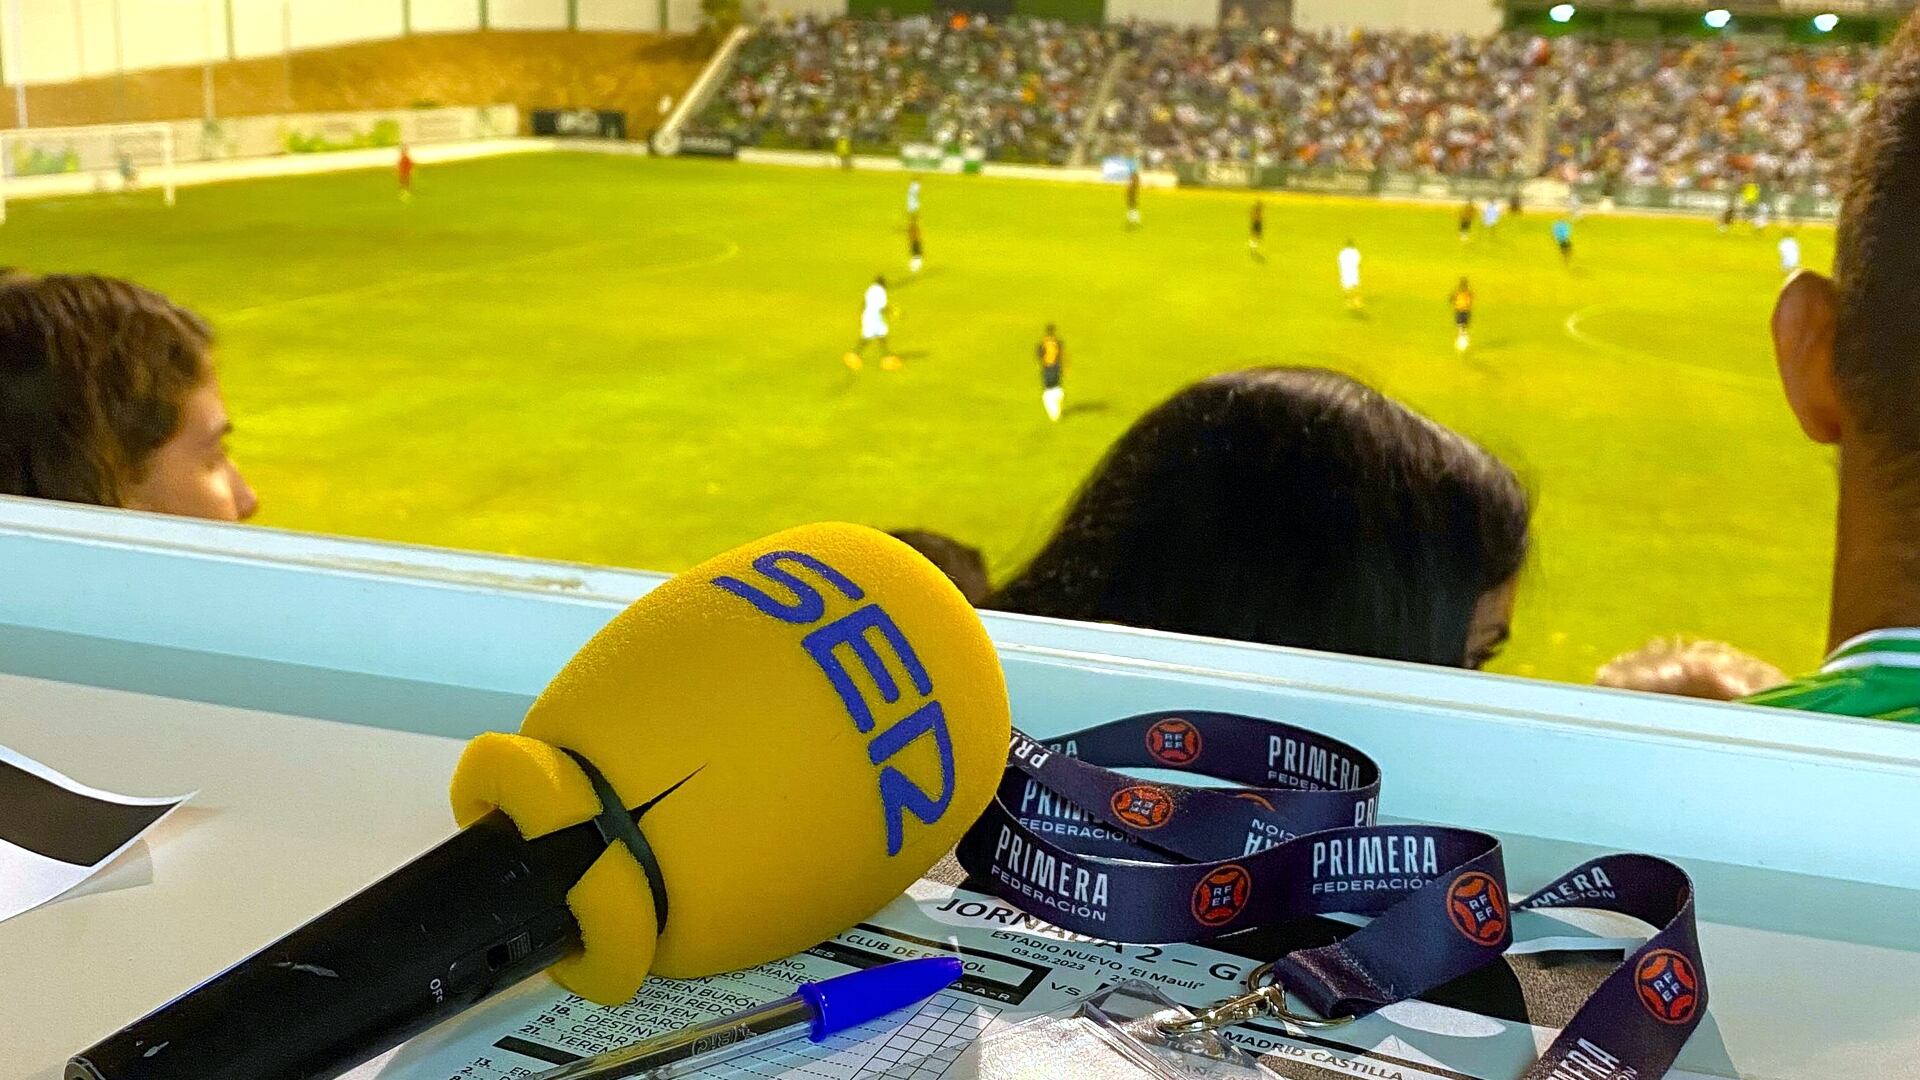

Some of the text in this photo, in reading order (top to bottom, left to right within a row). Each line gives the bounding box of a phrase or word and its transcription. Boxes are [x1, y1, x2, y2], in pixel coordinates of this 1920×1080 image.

[710, 551, 956, 856] SER
[1268, 735, 1360, 793] PRIMERA
[994, 823, 1108, 907] PRIMERA
[1313, 835, 1438, 878] PRIMERA
[991, 864, 1106, 921] FEDERACIÓN
[846, 932, 891, 951] CLUB
[893, 946, 919, 958] DE
[991, 930, 1061, 954] ESTADIO
[1063, 949, 1123, 971] NUEVO
[1135, 946, 1164, 964] 2
[1011, 946, 1087, 971] 03.09.2023
[1051, 982, 1082, 997] VS
[535, 1014, 556, 1026] 19.
[550, 1004, 661, 1038] 18. DESTINY
[597, 1005, 635, 1018] ALE
[519, 1025, 540, 1036] 21.
[474, 1057, 492, 1068] 13.
[1222, 1031, 1310, 1057] MADRID
[1310, 1051, 1404, 1080] CASTILLA
[461, 1066, 473, 1075] 2.
